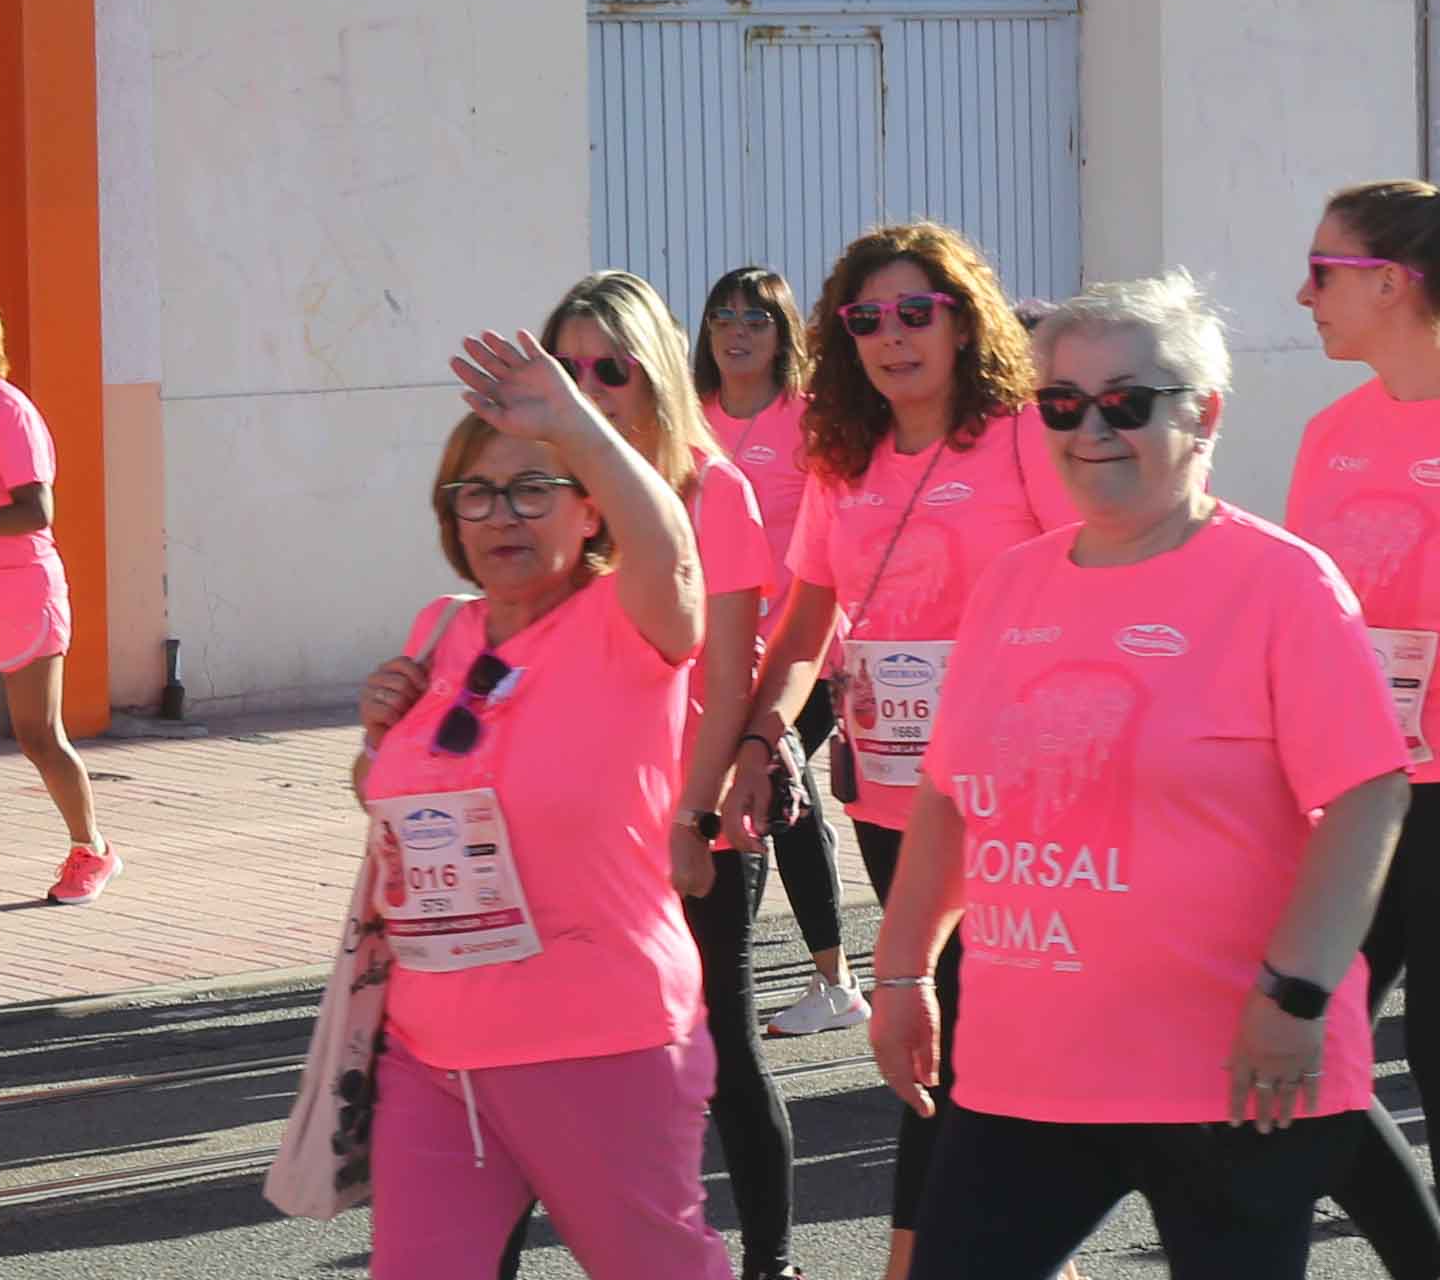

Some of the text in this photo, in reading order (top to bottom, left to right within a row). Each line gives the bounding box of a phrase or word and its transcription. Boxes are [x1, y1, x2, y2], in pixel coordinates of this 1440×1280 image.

[881, 699, 929, 719] 016
[952, 775, 998, 817] TU
[410, 863, 458, 890] 016
